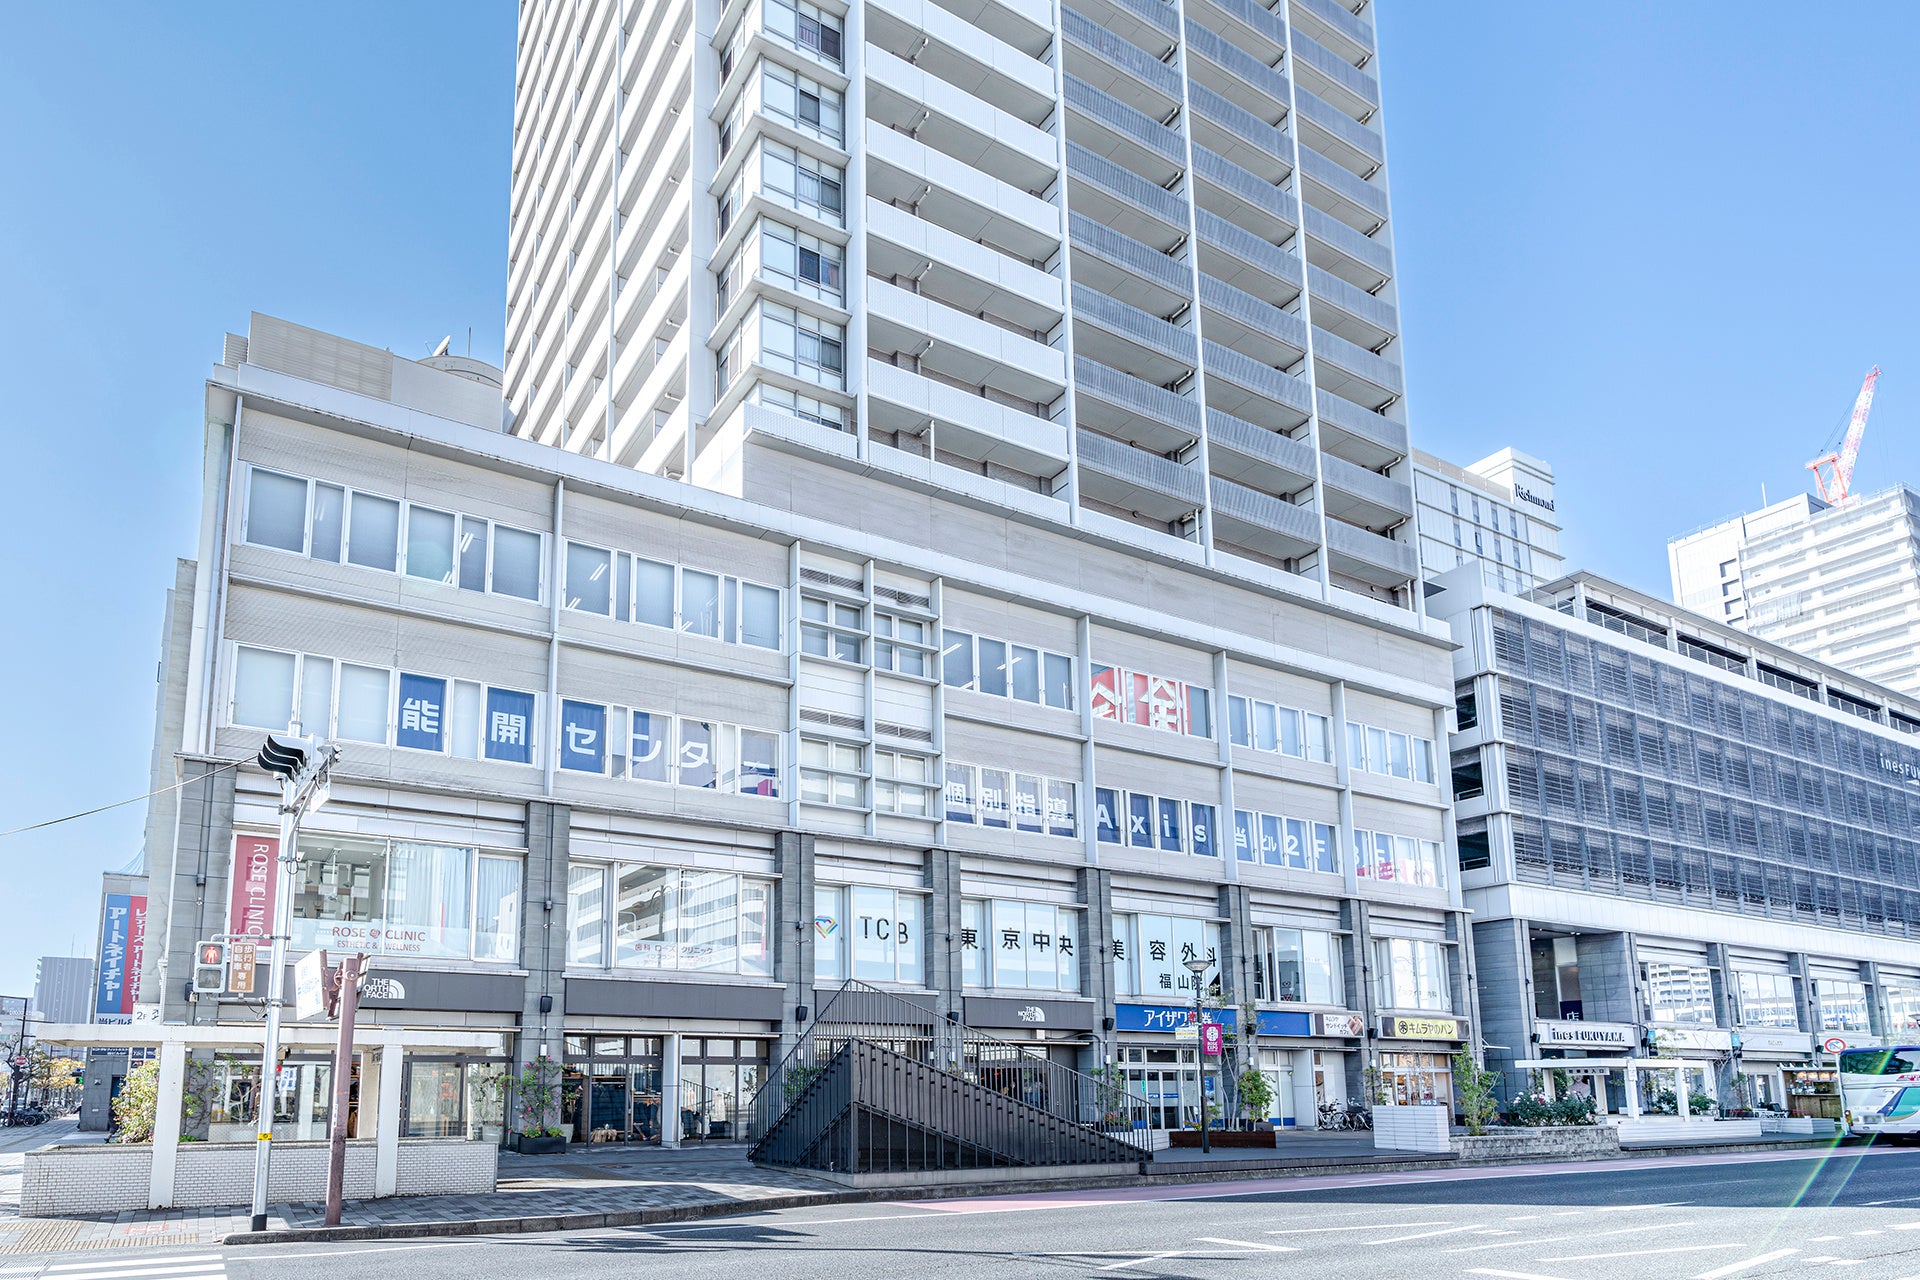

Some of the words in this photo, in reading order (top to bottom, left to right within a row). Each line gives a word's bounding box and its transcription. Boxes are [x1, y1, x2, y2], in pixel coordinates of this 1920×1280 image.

[402, 697, 770, 770] 能開センター
[1905, 763, 1920, 779] FU
[947, 780, 1068, 822] 個別指導
[1096, 804, 1206, 842] Axis
[251, 844, 269, 883] ROSE
[247, 887, 266, 937] CLINIC
[332, 926, 366, 938] ROSE
[385, 930, 426, 941] CLINIC
[860, 916, 909, 945] TCB
[961, 927, 1074, 957] 東京中央
[103, 907, 127, 1001] アートネイチャー
[385, 943, 421, 952] WELLNESS
[681, 946, 713, 954] クリニック
[1144, 1009, 1213, 1028] アイザワ券
[1409, 1022, 1454, 1035] キムラヤのパン
[1552, 1028, 1574, 1040] ines
[1575, 1030, 1625, 1042] FUKUYAMA
